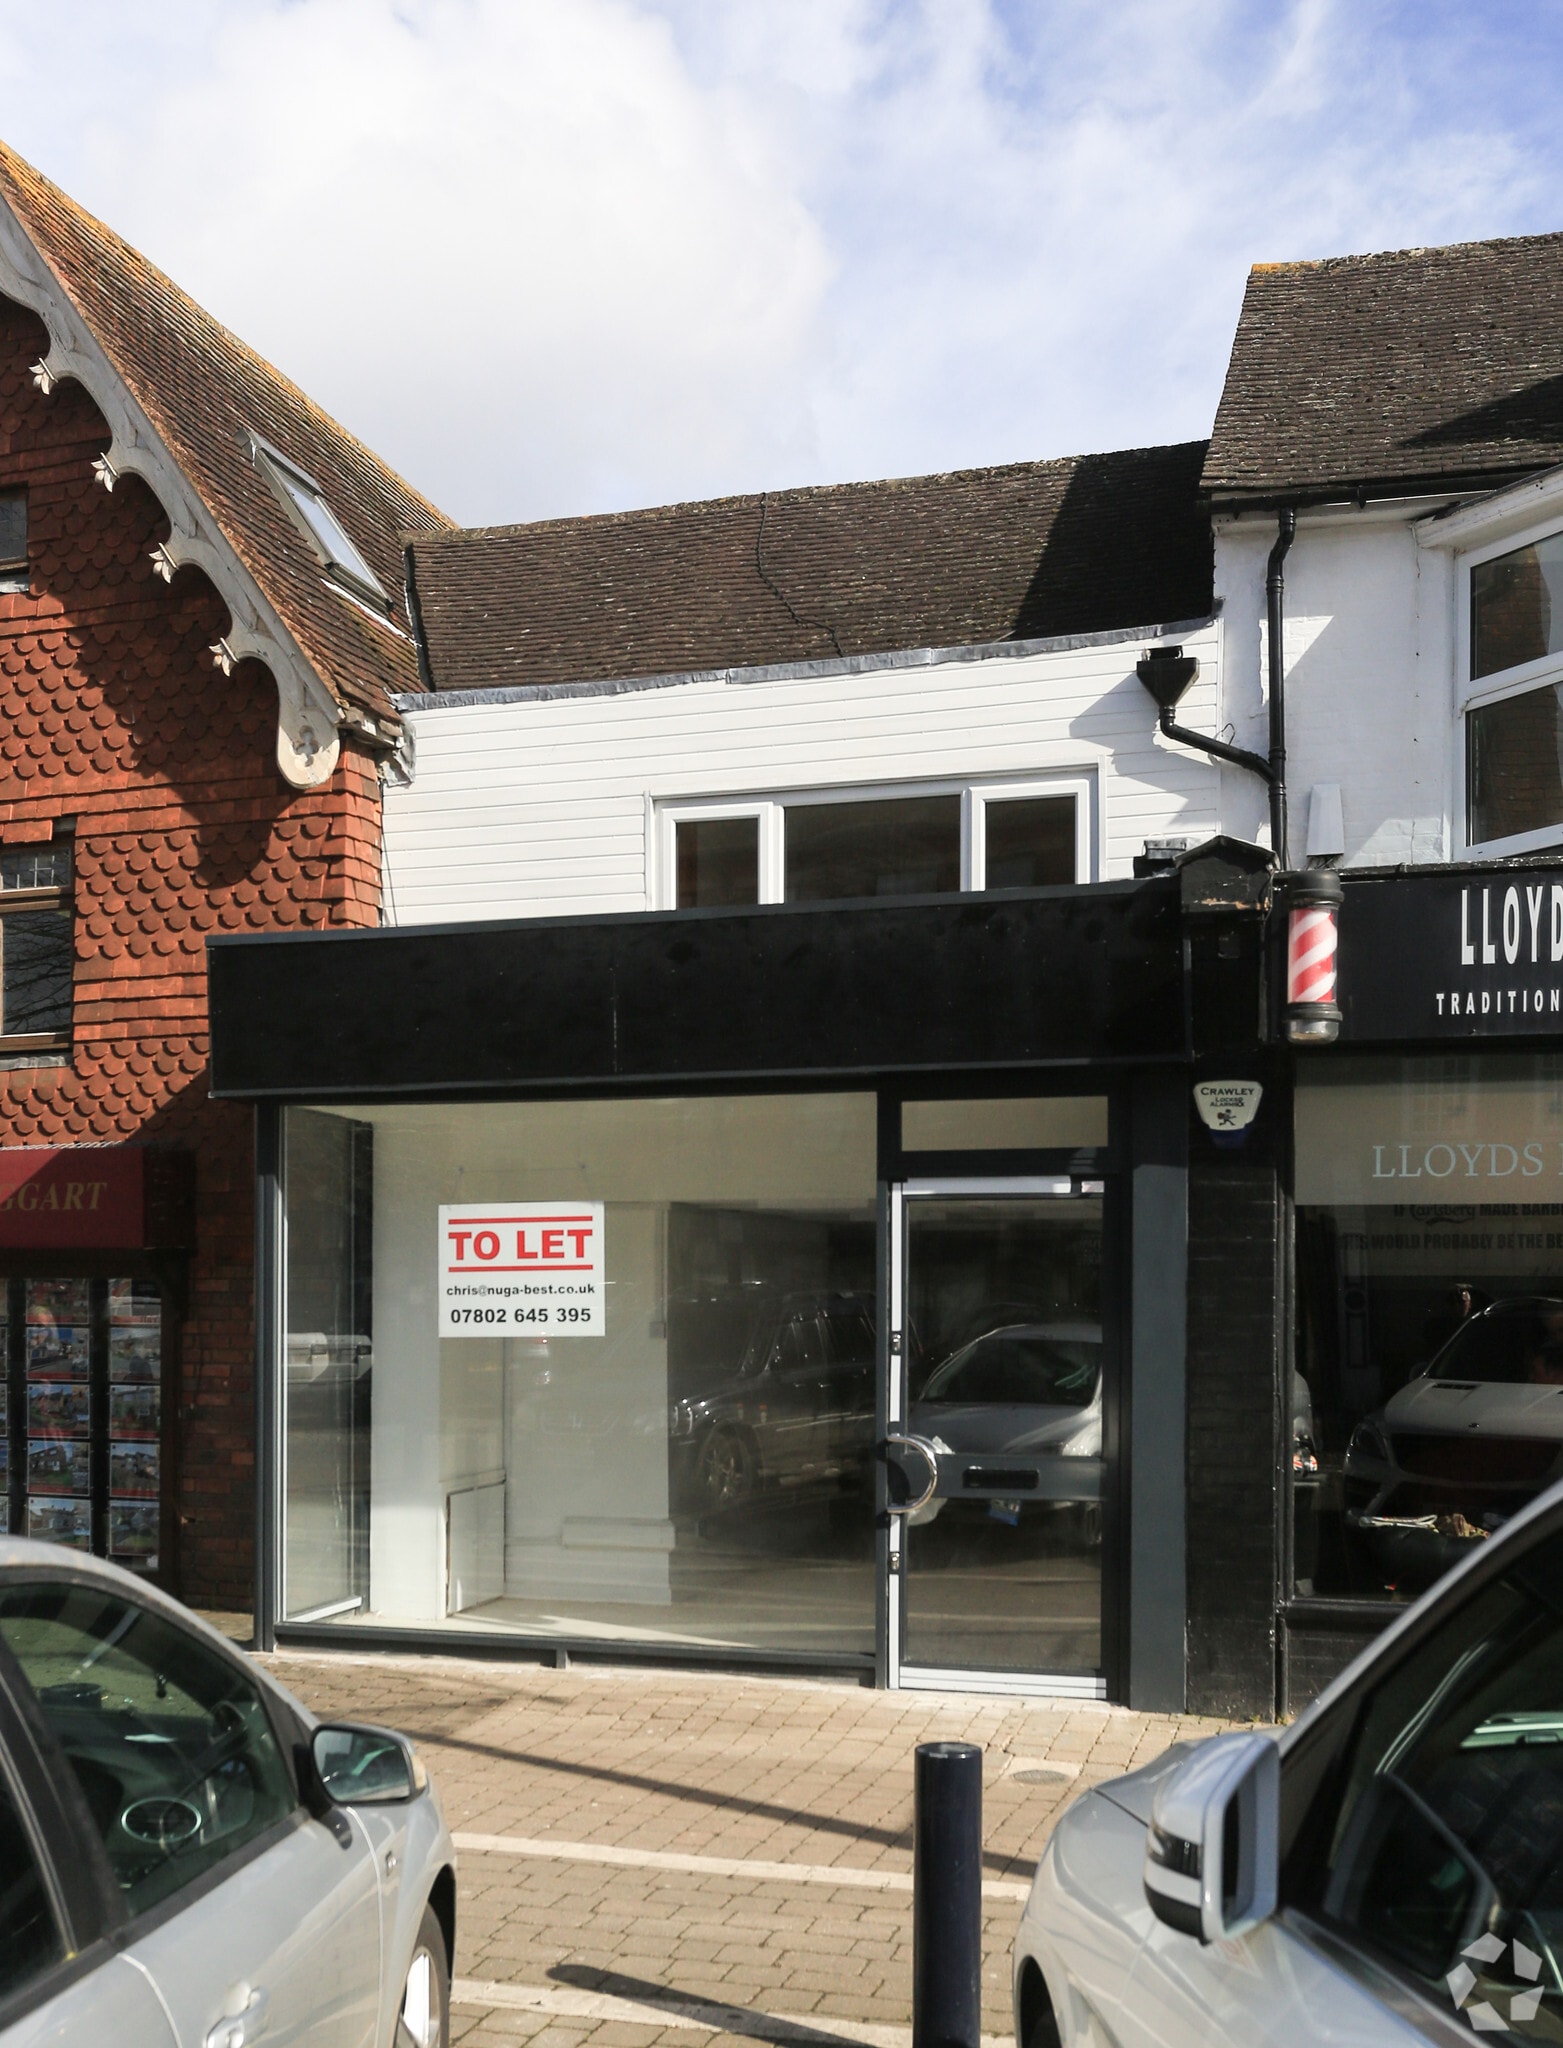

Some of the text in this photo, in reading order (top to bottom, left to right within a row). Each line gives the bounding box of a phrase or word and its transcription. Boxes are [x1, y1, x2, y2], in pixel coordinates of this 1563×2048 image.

[1461, 885, 1563, 965] LLOYD
[1436, 989, 1560, 1015] TRADITION
[1200, 1087, 1255, 1096] CRAWLEY
[1372, 1142, 1543, 1177] LLOYDS
[448, 1229, 593, 1260] TO LET
[1371, 1234, 1421, 1249] WOULD
[1424, 1233, 1494, 1249] PROBABLY
[1497, 1233, 1515, 1249] BE
[1517, 1233, 1544, 1249] THE
[446, 1284, 595, 1297] chris@nuga-best.co.uk
[451, 1308, 591, 1323] 07802 645 395
